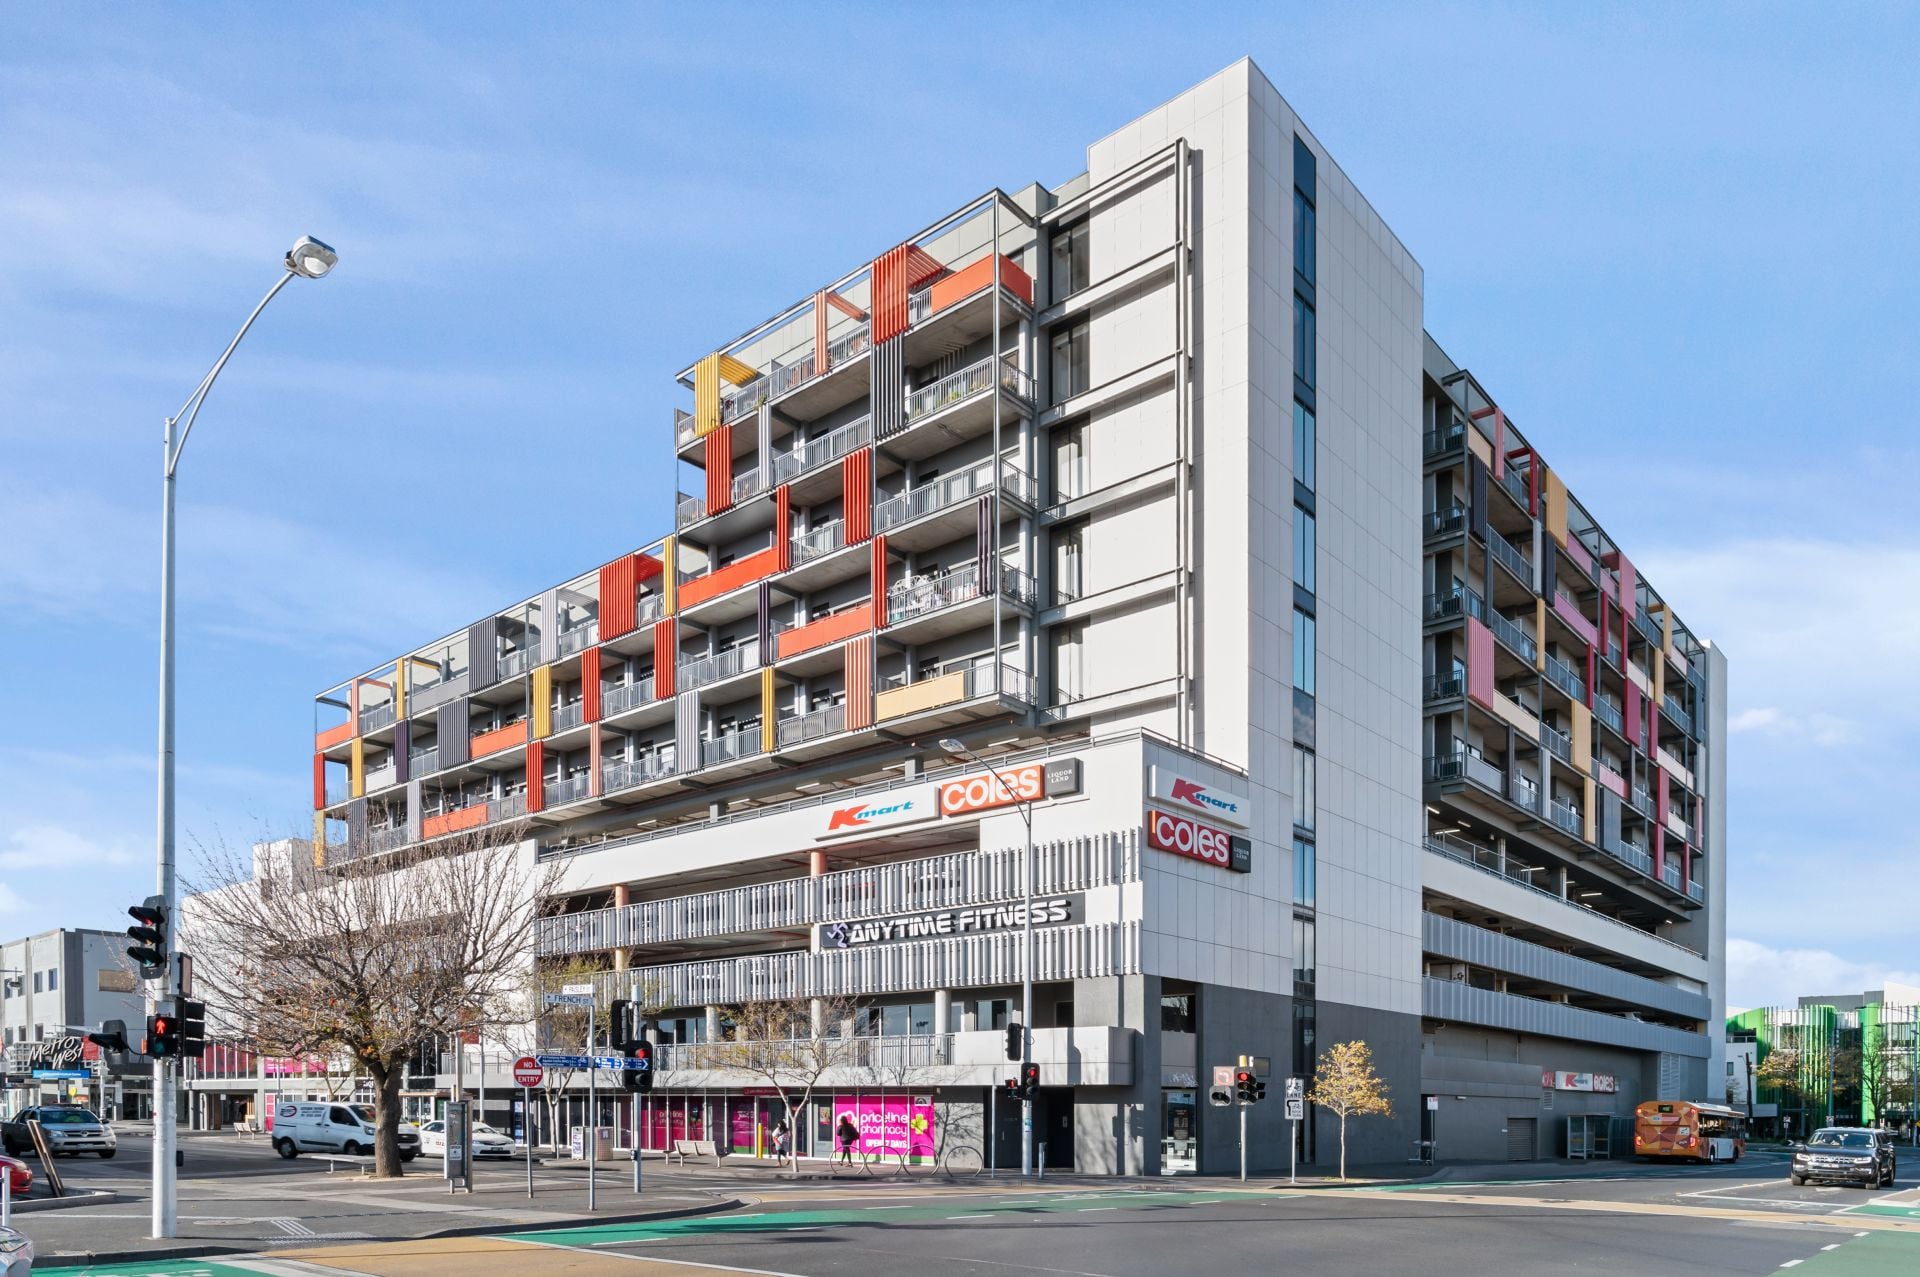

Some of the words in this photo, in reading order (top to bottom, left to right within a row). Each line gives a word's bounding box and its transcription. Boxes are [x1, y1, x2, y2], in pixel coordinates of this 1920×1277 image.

[1047, 769, 1073, 779] LIQUOR
[1051, 775, 1069, 784] LAND
[943, 768, 1039, 811] coles
[1171, 778, 1238, 813] Kmart
[828, 801, 914, 830] Kmart
[1156, 815, 1229, 863] coles
[850, 913, 951, 943] ANYTIME
[959, 899, 1070, 932] FITNESS
[554, 994, 580, 1004] FRENCH
[27, 1036, 82, 1066] Metro
[52, 1042, 84, 1070] West
[860, 1112, 908, 1124] priceline
[860, 1125, 908, 1137] pharmacy
[866, 1140, 882, 1148] OPEN
[891, 1140, 907, 1149] DAYS
